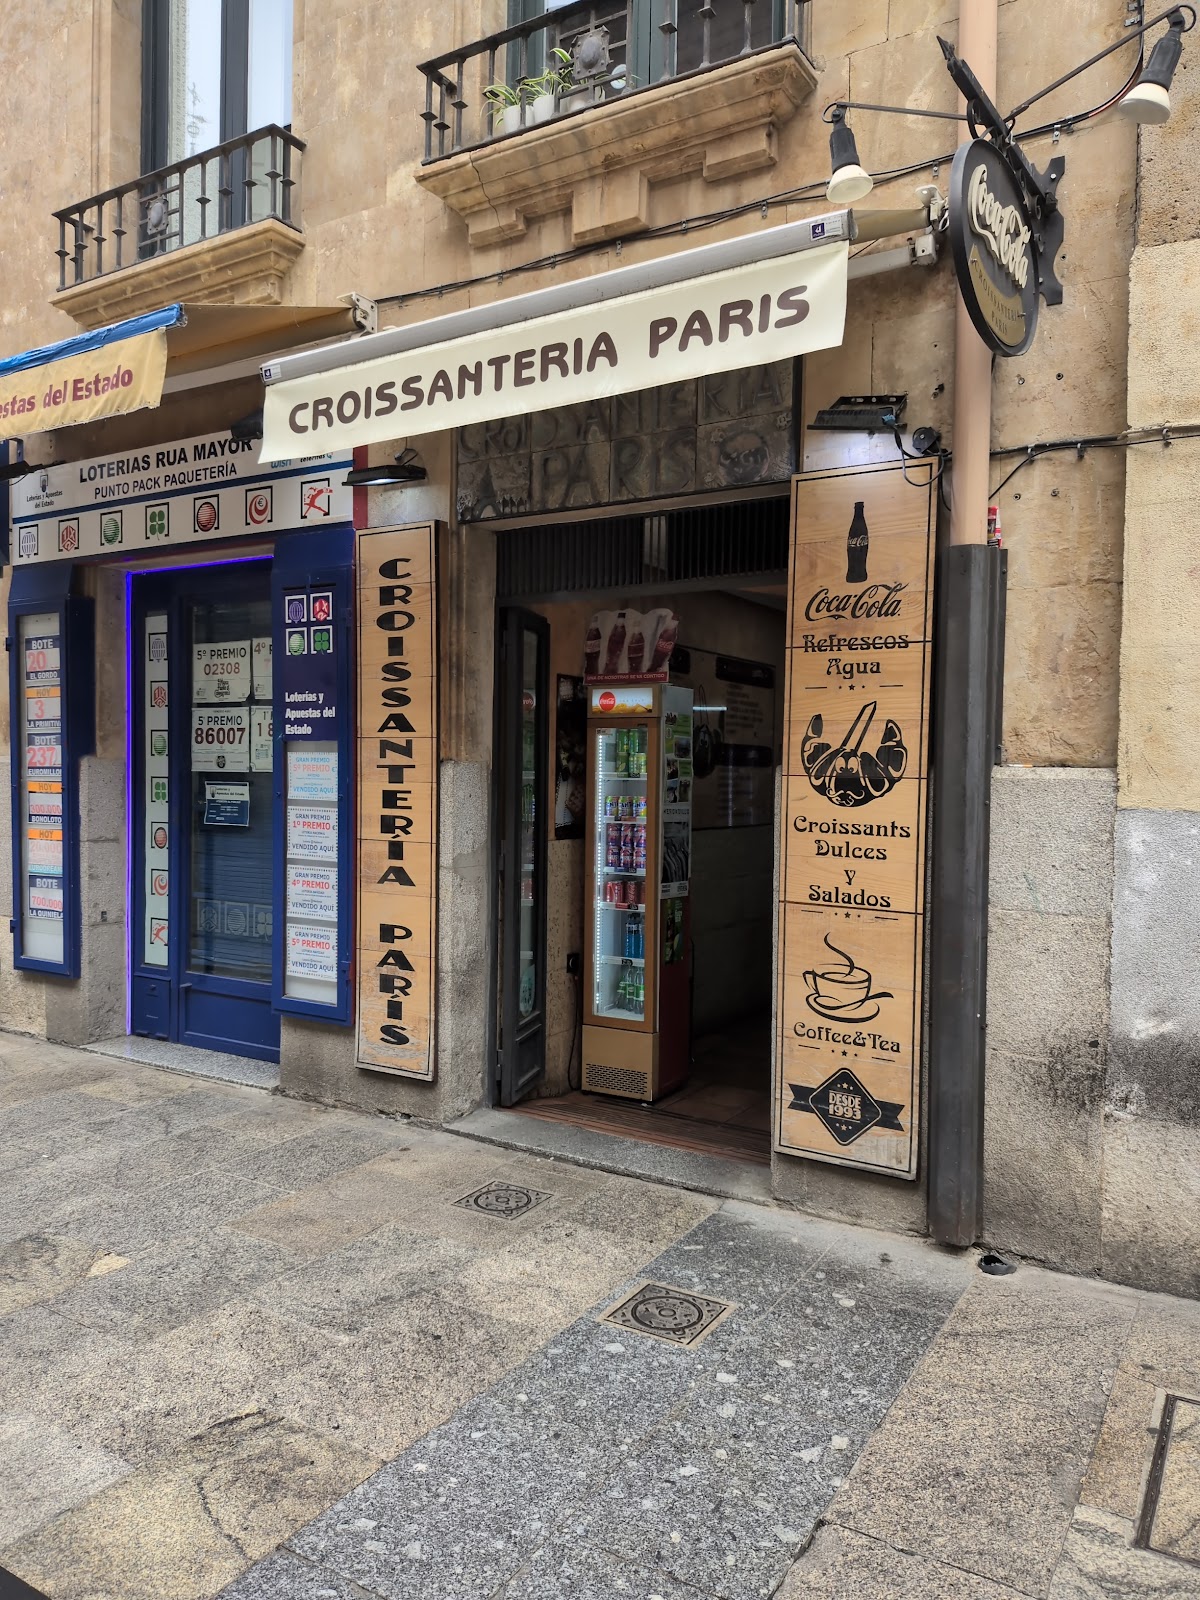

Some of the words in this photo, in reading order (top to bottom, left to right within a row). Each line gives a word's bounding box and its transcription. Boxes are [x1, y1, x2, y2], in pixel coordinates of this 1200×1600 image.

[288, 332, 618, 434] CROISSANTERIA
[648, 284, 811, 359] PARIS
[43, 380, 67, 408] del
[72, 365, 133, 401] Estado
[79, 455, 151, 483] LOTERIAS
[157, 447, 188, 468] RUA
[193, 437, 253, 461] MAYOR
[94, 482, 130, 499] PUNTO
[132, 477, 161, 494] PACK
[164, 462, 237, 487] PAQUETERÍA
[31, 639, 53, 650] BOTE
[802, 633, 909, 653] Refrescos
[210, 647, 247, 660] PREMIO
[28, 651, 46, 672] 20
[204, 662, 240, 675] 02308
[826, 658, 881, 679] Agua
[38, 671, 58, 680] GORDO
[36, 688, 51, 697] HOY
[285, 691, 317, 703] Loterías
[318, 692, 324, 704] y
[35, 700, 45, 719] 3
[285, 707, 321, 721] Apuestas
[322, 706, 336, 718] del
[207, 715, 243, 726] PREMIO
[377, 557, 417, 888] CROISSANTERÍA
[194, 727, 246, 744] 86007
[285, 723, 312, 735] Estado
[34, 735, 56, 745] BOTE
[27, 746, 57, 767] 237
[303, 764, 330, 772] PREMIO
[38, 783, 53, 791] HOY
[31, 815, 62, 824] BONOLOTO
[302, 821, 331, 830] PREMIO
[793, 815, 911, 838] Croissants
[39, 830, 54, 839] HOY
[814, 839, 887, 860] Dulces
[36, 878, 58, 889] BOTE
[302, 880, 330, 889] PREMIO
[808, 885, 892, 908] Salados
[29, 909, 37, 917] LA
[302, 940, 330, 950] PREMIO
[291, 961, 318, 969] VENDIDO
[376, 923, 415, 1045] PARÍS
[793, 1021, 901, 1053] Coffee&Tea
[828, 1091, 861, 1109] DESDE
[828, 1104, 861, 1121] 1993
